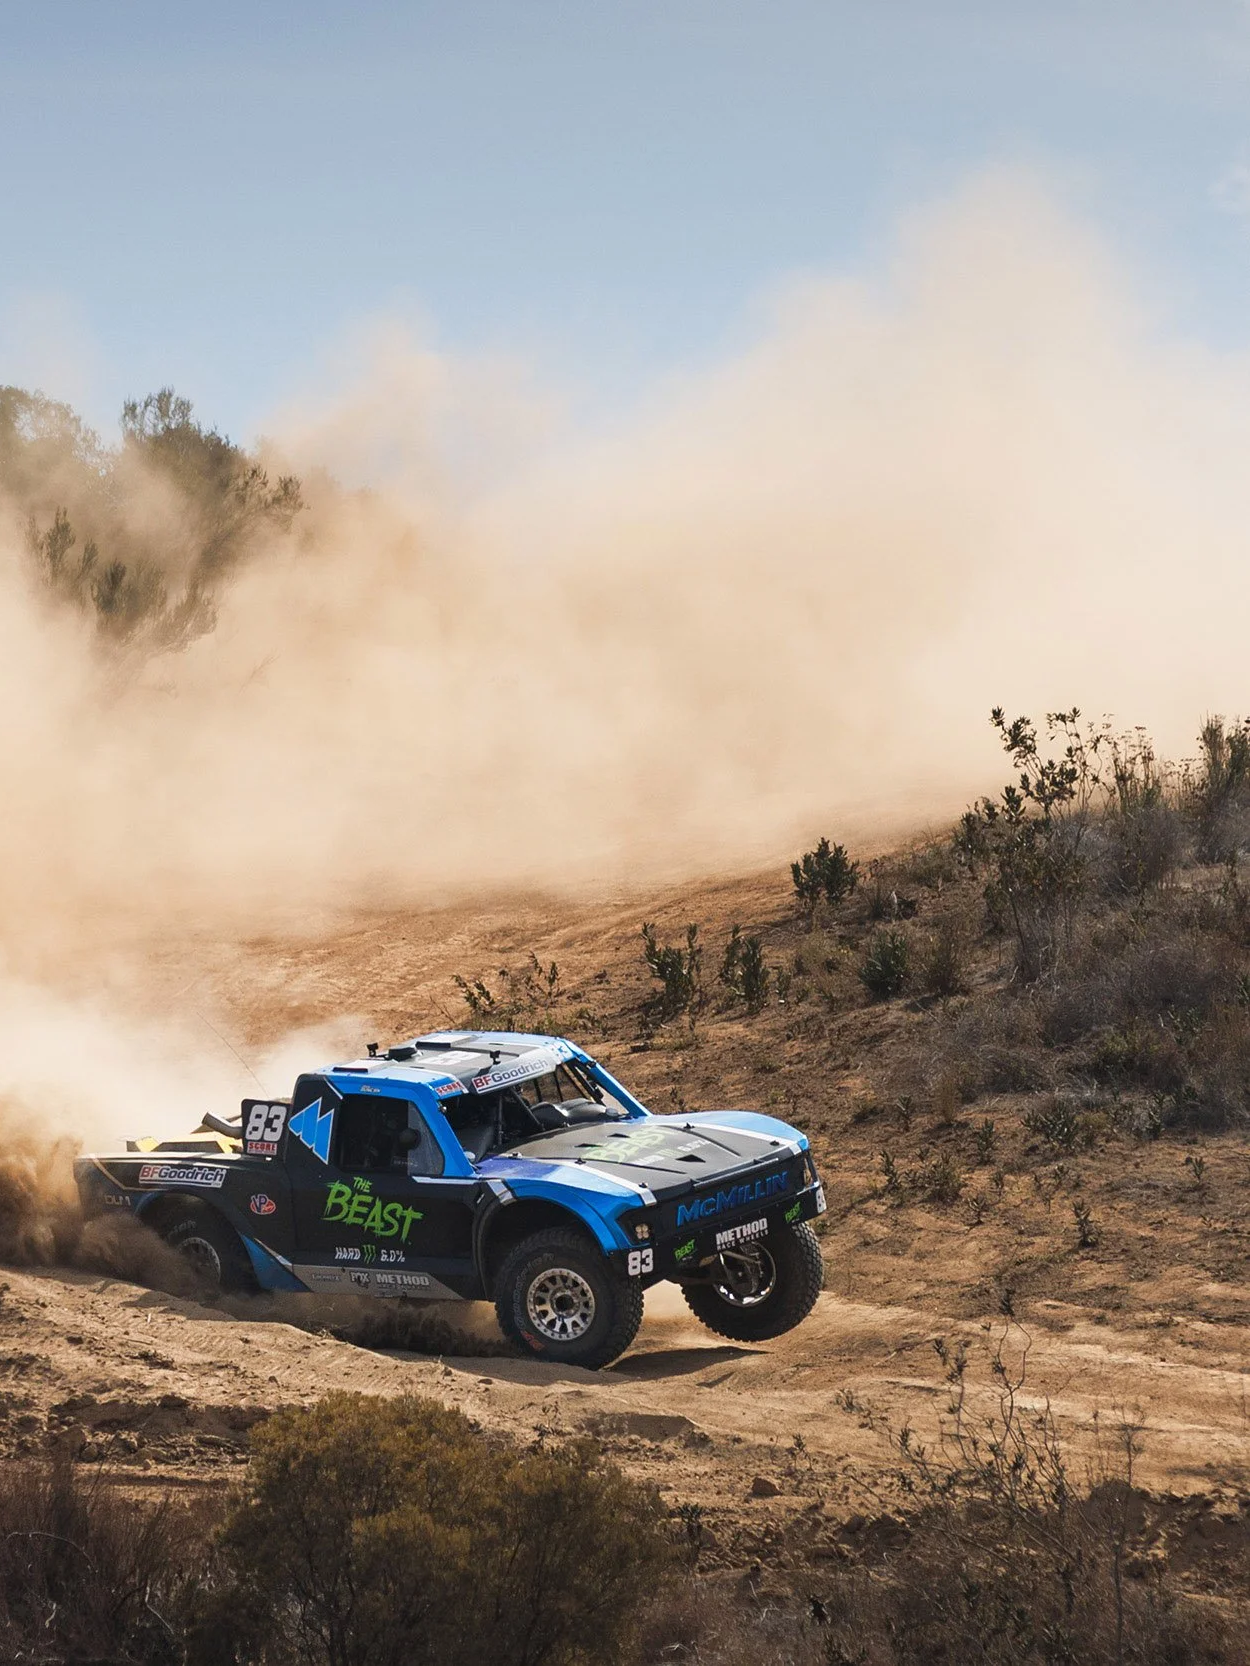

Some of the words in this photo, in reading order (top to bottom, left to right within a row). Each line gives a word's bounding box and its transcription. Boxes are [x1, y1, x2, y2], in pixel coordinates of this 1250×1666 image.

[473, 1059, 549, 1089] BFGoodrich
[245, 1104, 287, 1142] 83
[248, 1142, 277, 1151] SCORE
[139, 1165, 225, 1182] BFGoodrich
[353, 1176, 373, 1192] THE
[321, 1180, 424, 1244] BEAST
[716, 1217, 768, 1245] METHOD
[334, 1247, 361, 1260] HARD
[717, 1240, 736, 1251] RACE
[627, 1248, 654, 1276] 83
[375, 1273, 430, 1286] METHOD
